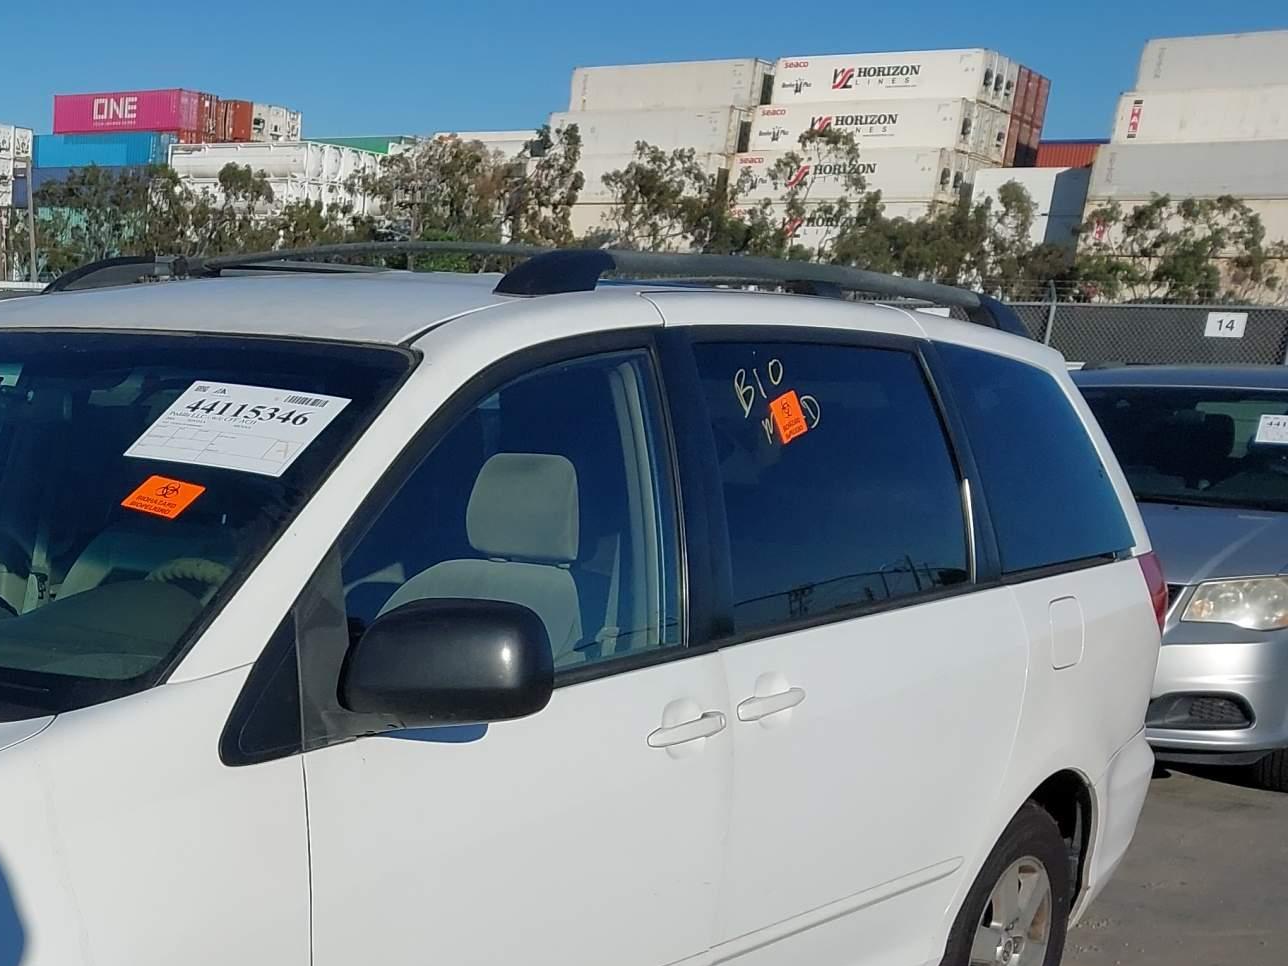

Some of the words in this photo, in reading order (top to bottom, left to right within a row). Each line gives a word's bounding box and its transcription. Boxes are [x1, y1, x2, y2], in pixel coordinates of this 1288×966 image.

[857, 64, 921, 78] HORIZON
[855, 77, 910, 86] LINES
[93, 96, 138, 120] ONE
[834, 113, 898, 126] HORIZON
[813, 163, 877, 175] HORIZON
[1217, 318, 1235, 331] 14
[185, 398, 314, 426] 44115346
